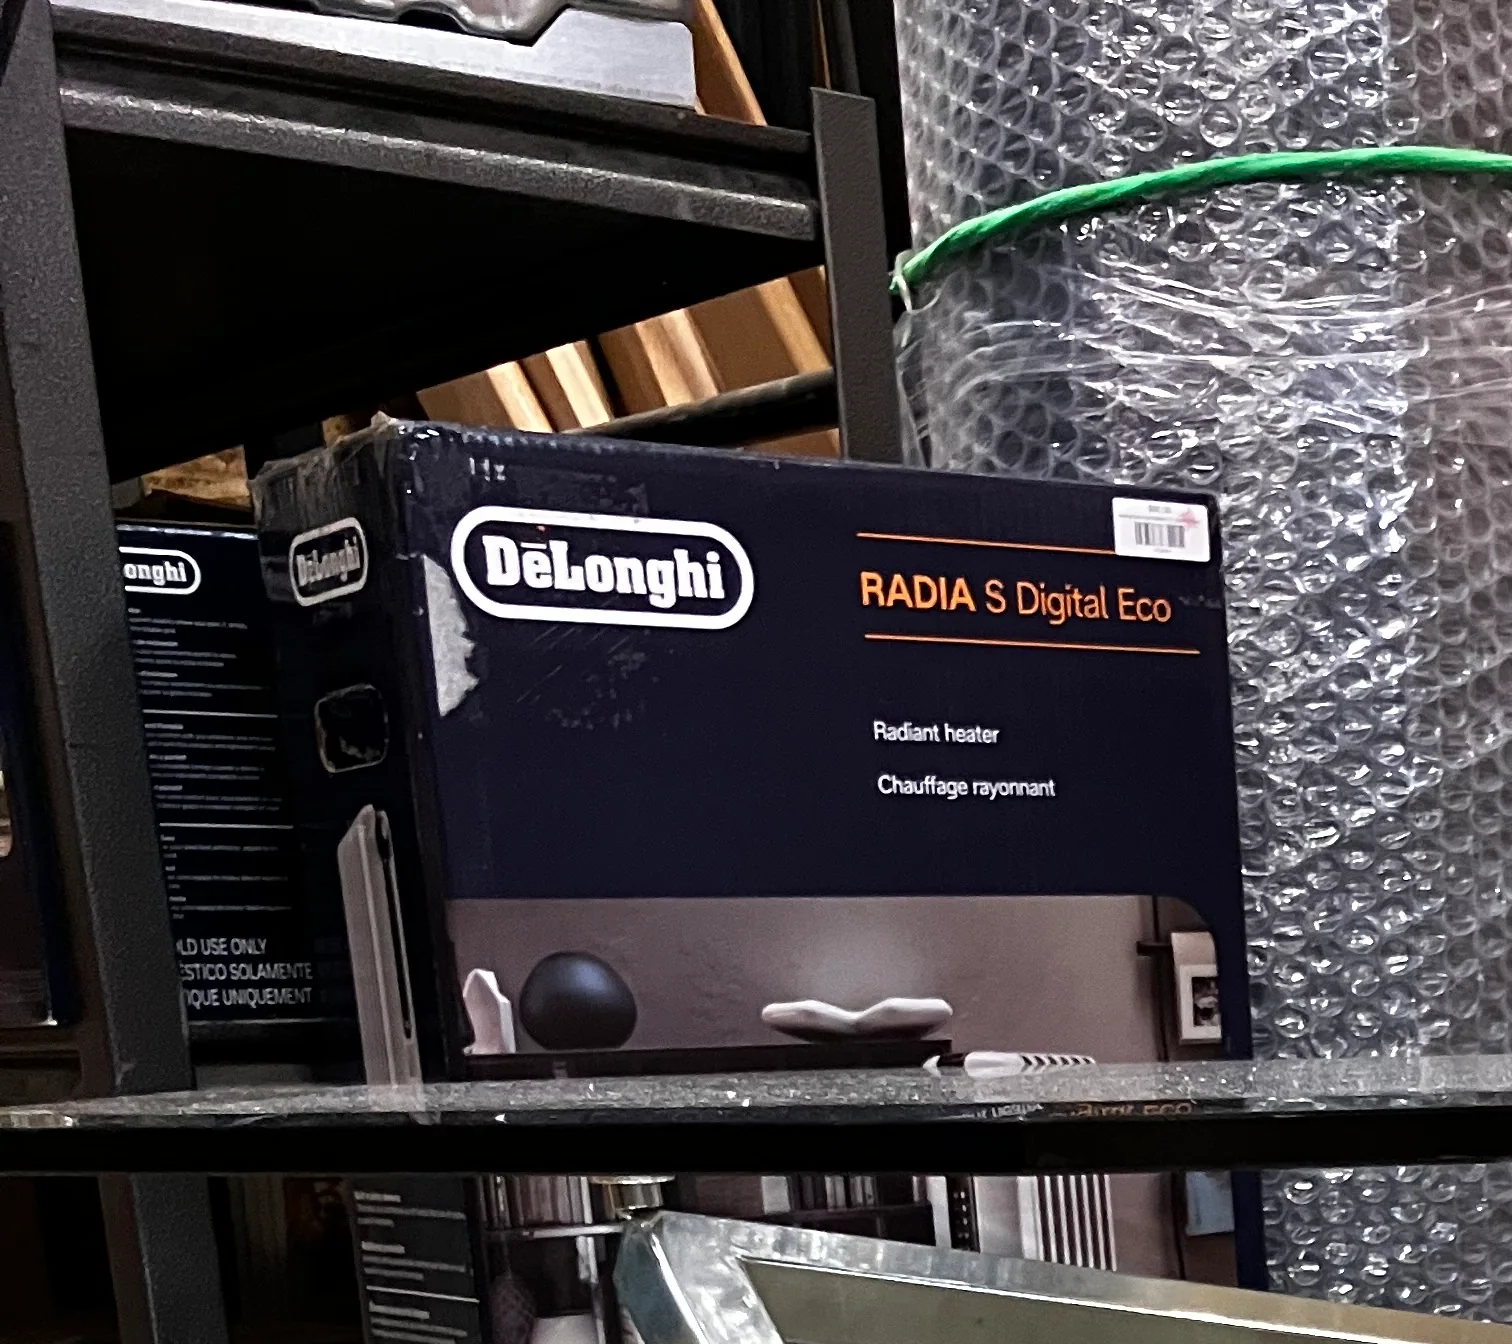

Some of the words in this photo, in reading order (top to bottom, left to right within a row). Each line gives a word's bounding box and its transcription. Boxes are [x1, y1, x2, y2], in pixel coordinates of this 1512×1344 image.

[123, 560, 187, 586] onghi
[860, 571, 977, 612] RADIA
[984, 578, 1006, 614] S
[1016, 580, 1109, 625] Digital
[1117, 587, 1172, 623] Eco
[873, 720, 940, 743] Radiant
[944, 722, 1000, 744] heater
[877, 773, 969, 800] Chauffage
[971, 778, 1056, 801] rayonnant
[200, 937, 229, 956] USE
[230, 938, 267, 955] ONLY
[228, 962, 313, 981] SOLAMENTE
[222, 987, 313, 1008] UNIQUEMENT
